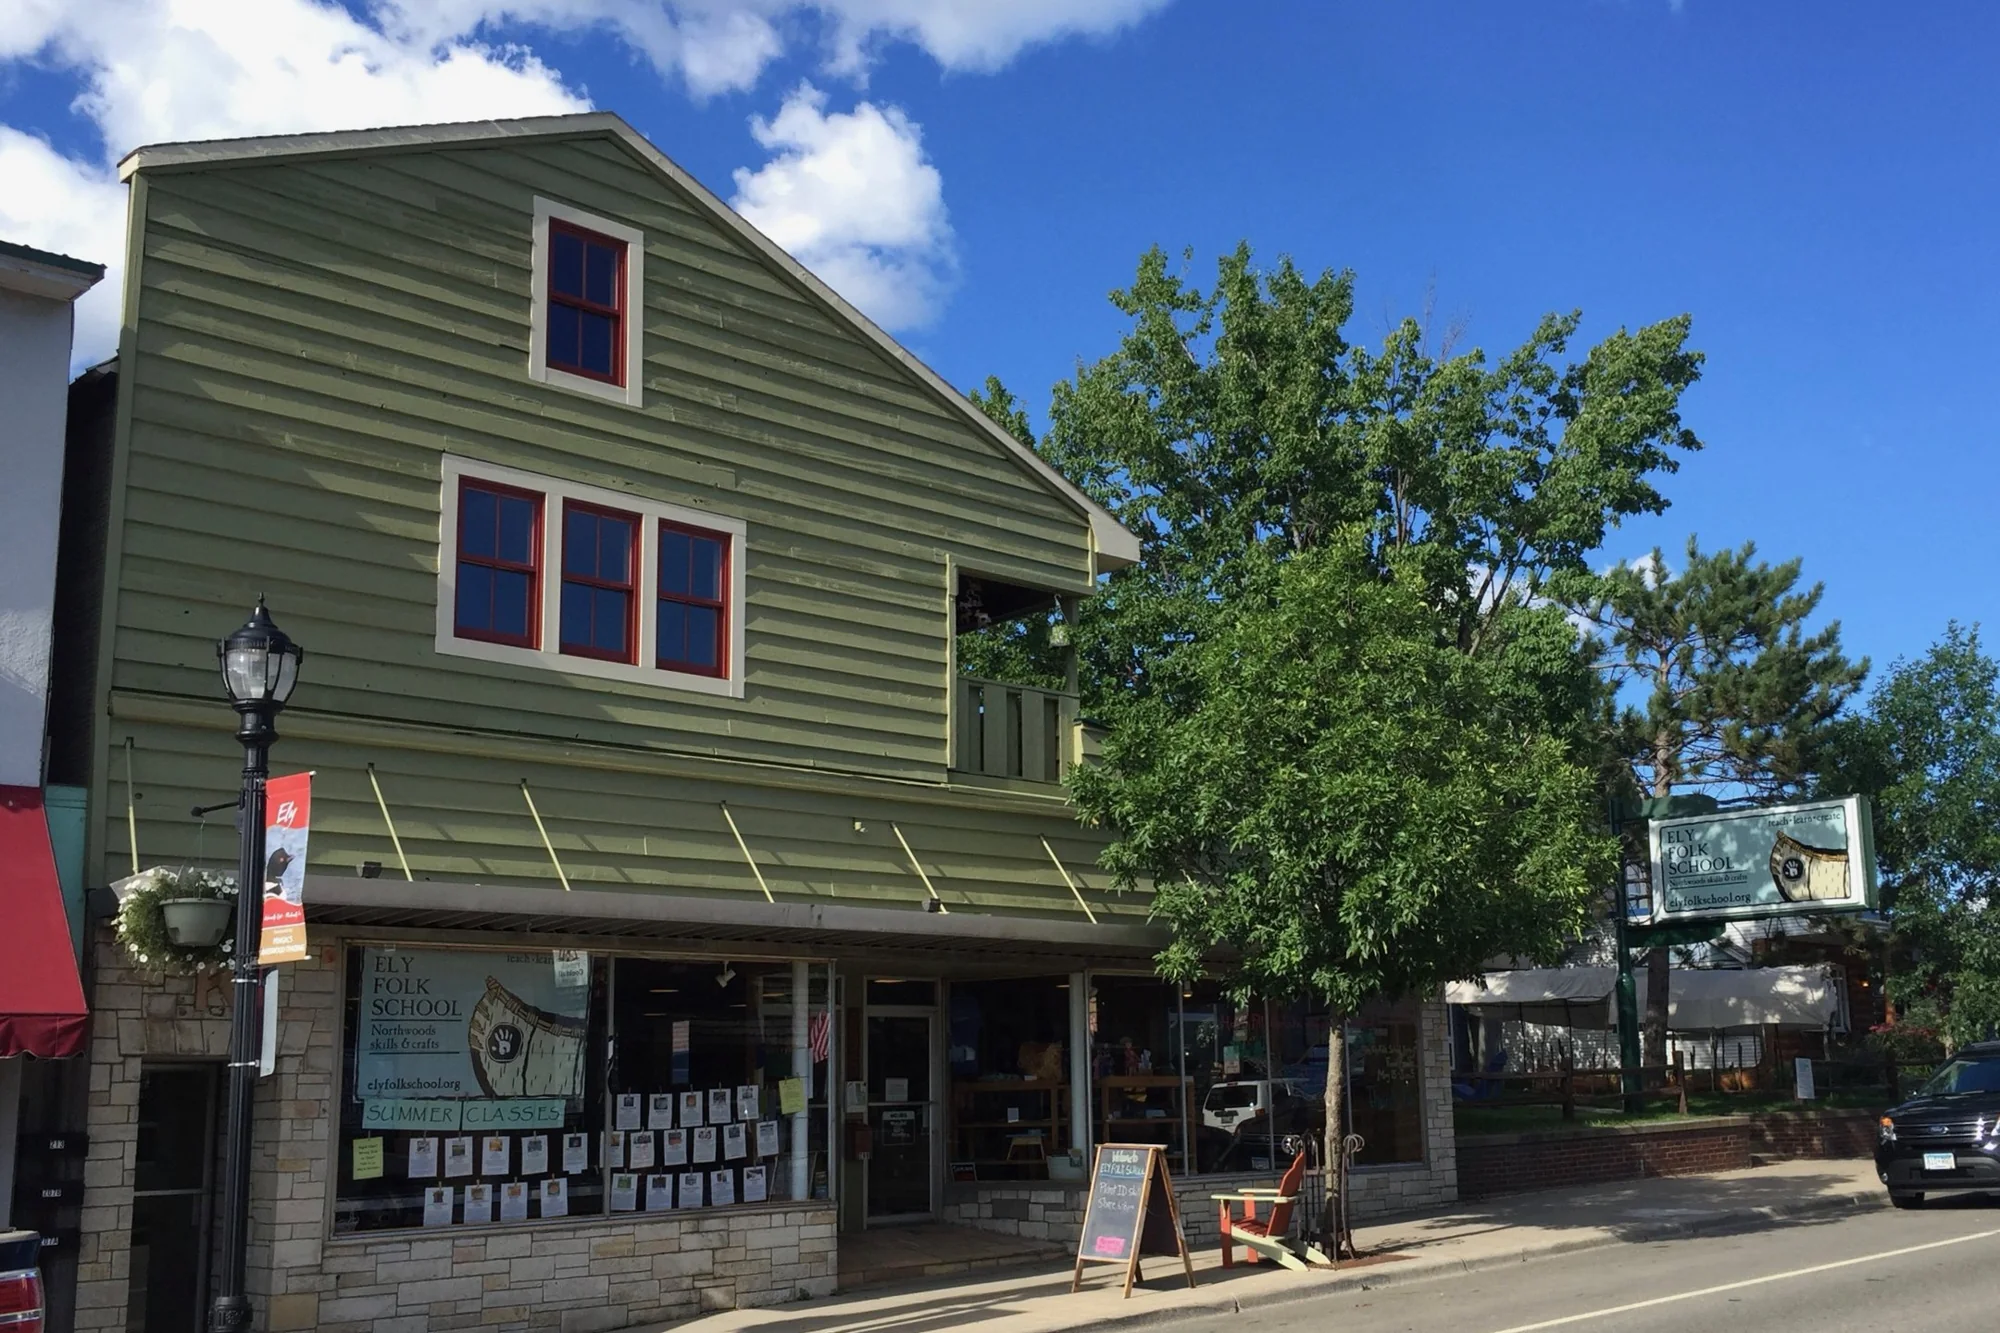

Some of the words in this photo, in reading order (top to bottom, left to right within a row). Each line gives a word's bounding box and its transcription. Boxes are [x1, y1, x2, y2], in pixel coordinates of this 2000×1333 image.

[276, 801, 298, 830] Ely
[1667, 828, 1695, 844] ELY
[1668, 843, 1708, 860] FOLK
[1668, 856, 1734, 876] SCHOOL
[1670, 892, 1751, 911] elyfolkschool.org
[374, 956, 414, 974] ELY
[374, 978, 431, 995] FOLK
[372, 998, 462, 1017] SCHOOL
[371, 1024, 436, 1037] Northwoods
[370, 1038, 397, 1050] skills
[401, 1038, 410, 1050] &
[411, 1038, 439, 1050] crafts
[367, 1077, 460, 1093] elyfolkschool.org
[366, 1104, 453, 1124] SUMMER
[466, 1105, 560, 1122] CLASSES
